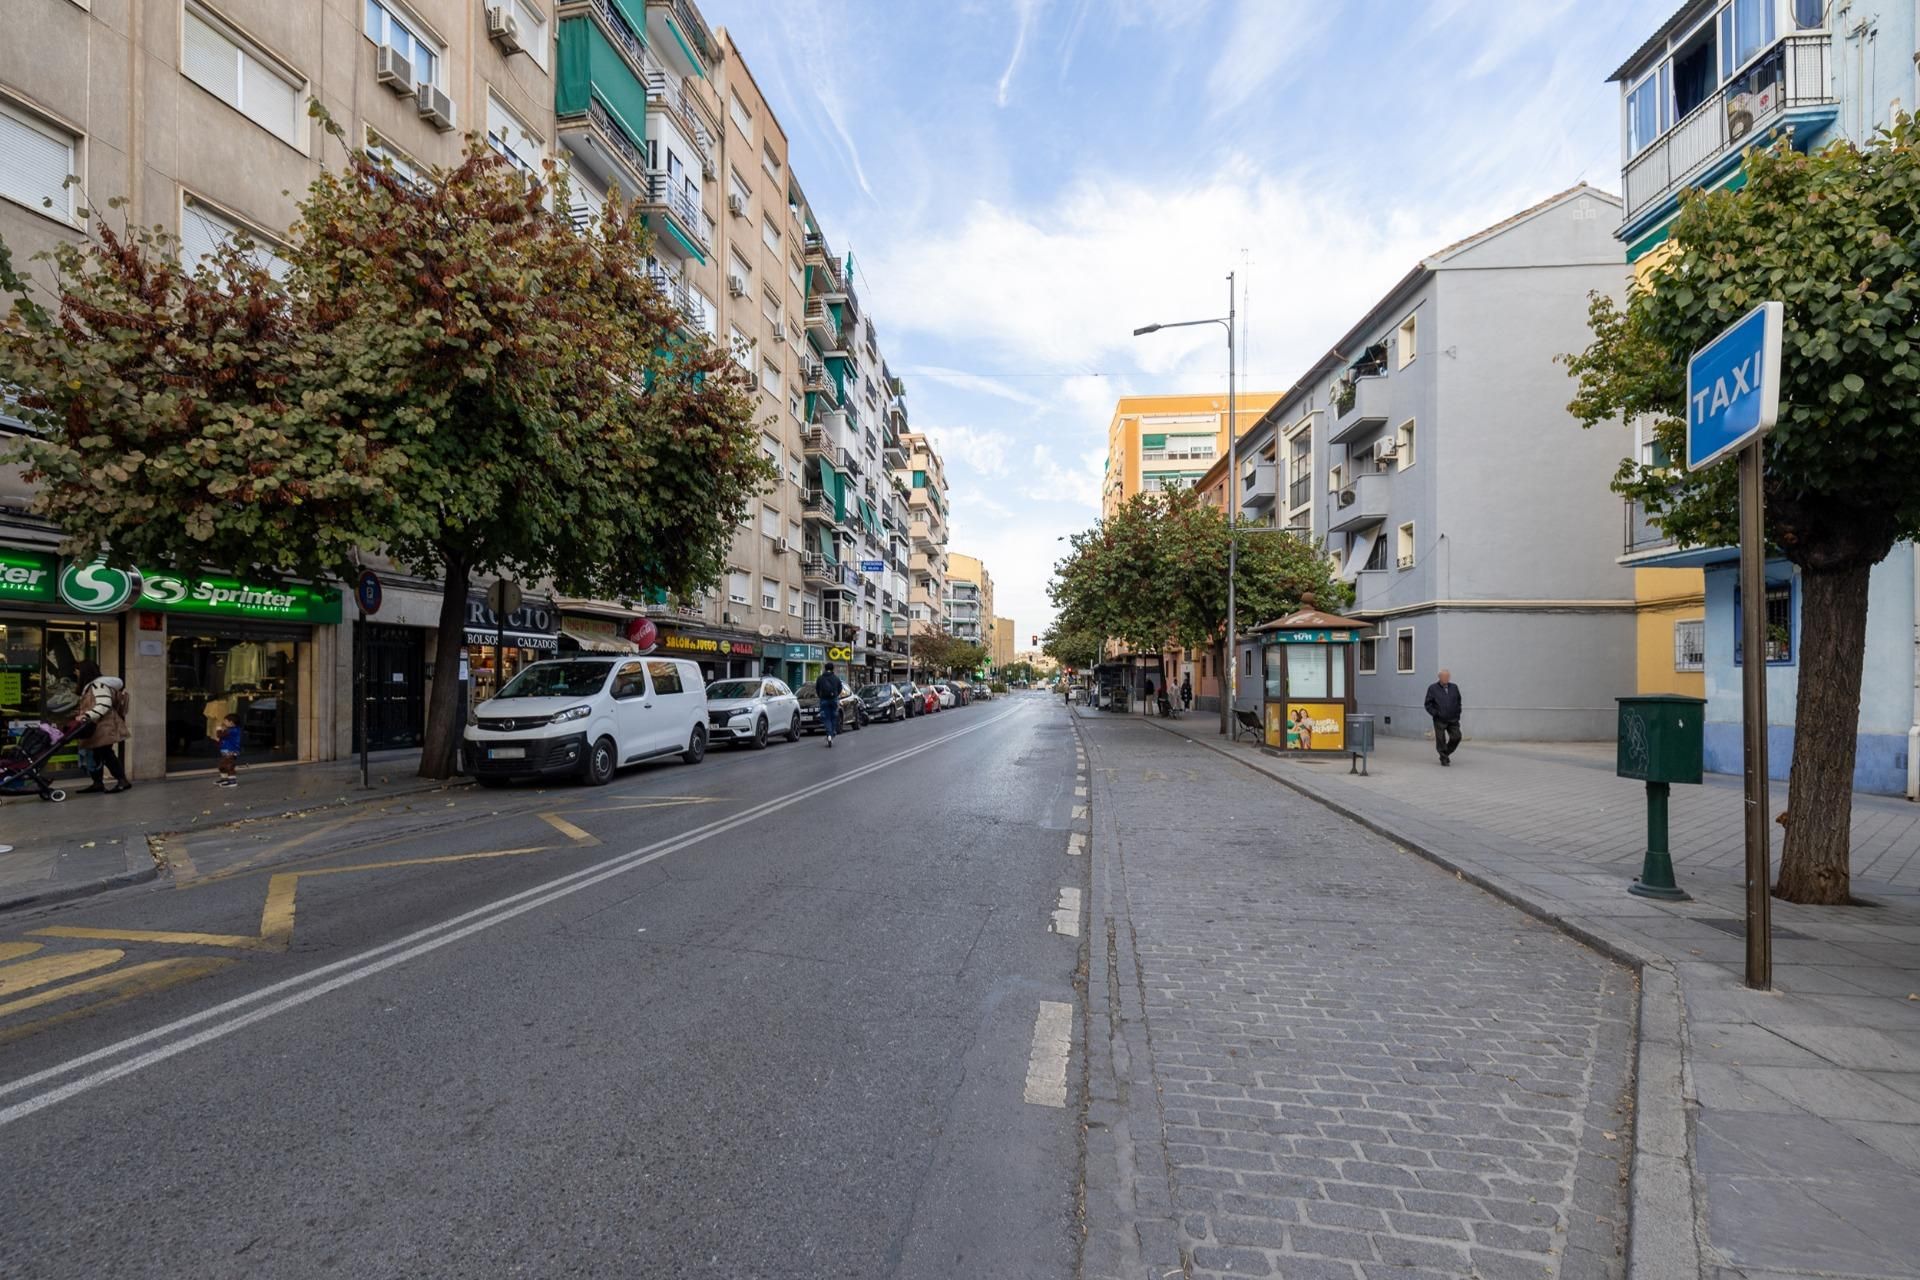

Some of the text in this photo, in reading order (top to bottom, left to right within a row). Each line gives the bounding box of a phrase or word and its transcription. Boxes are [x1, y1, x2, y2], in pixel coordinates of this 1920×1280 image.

[1693, 350, 1761, 425] TAXI
[192, 581, 297, 607] Sprinter
[518, 637, 558, 649] CALZADOS
[696, 639, 717, 652] JUEGO
